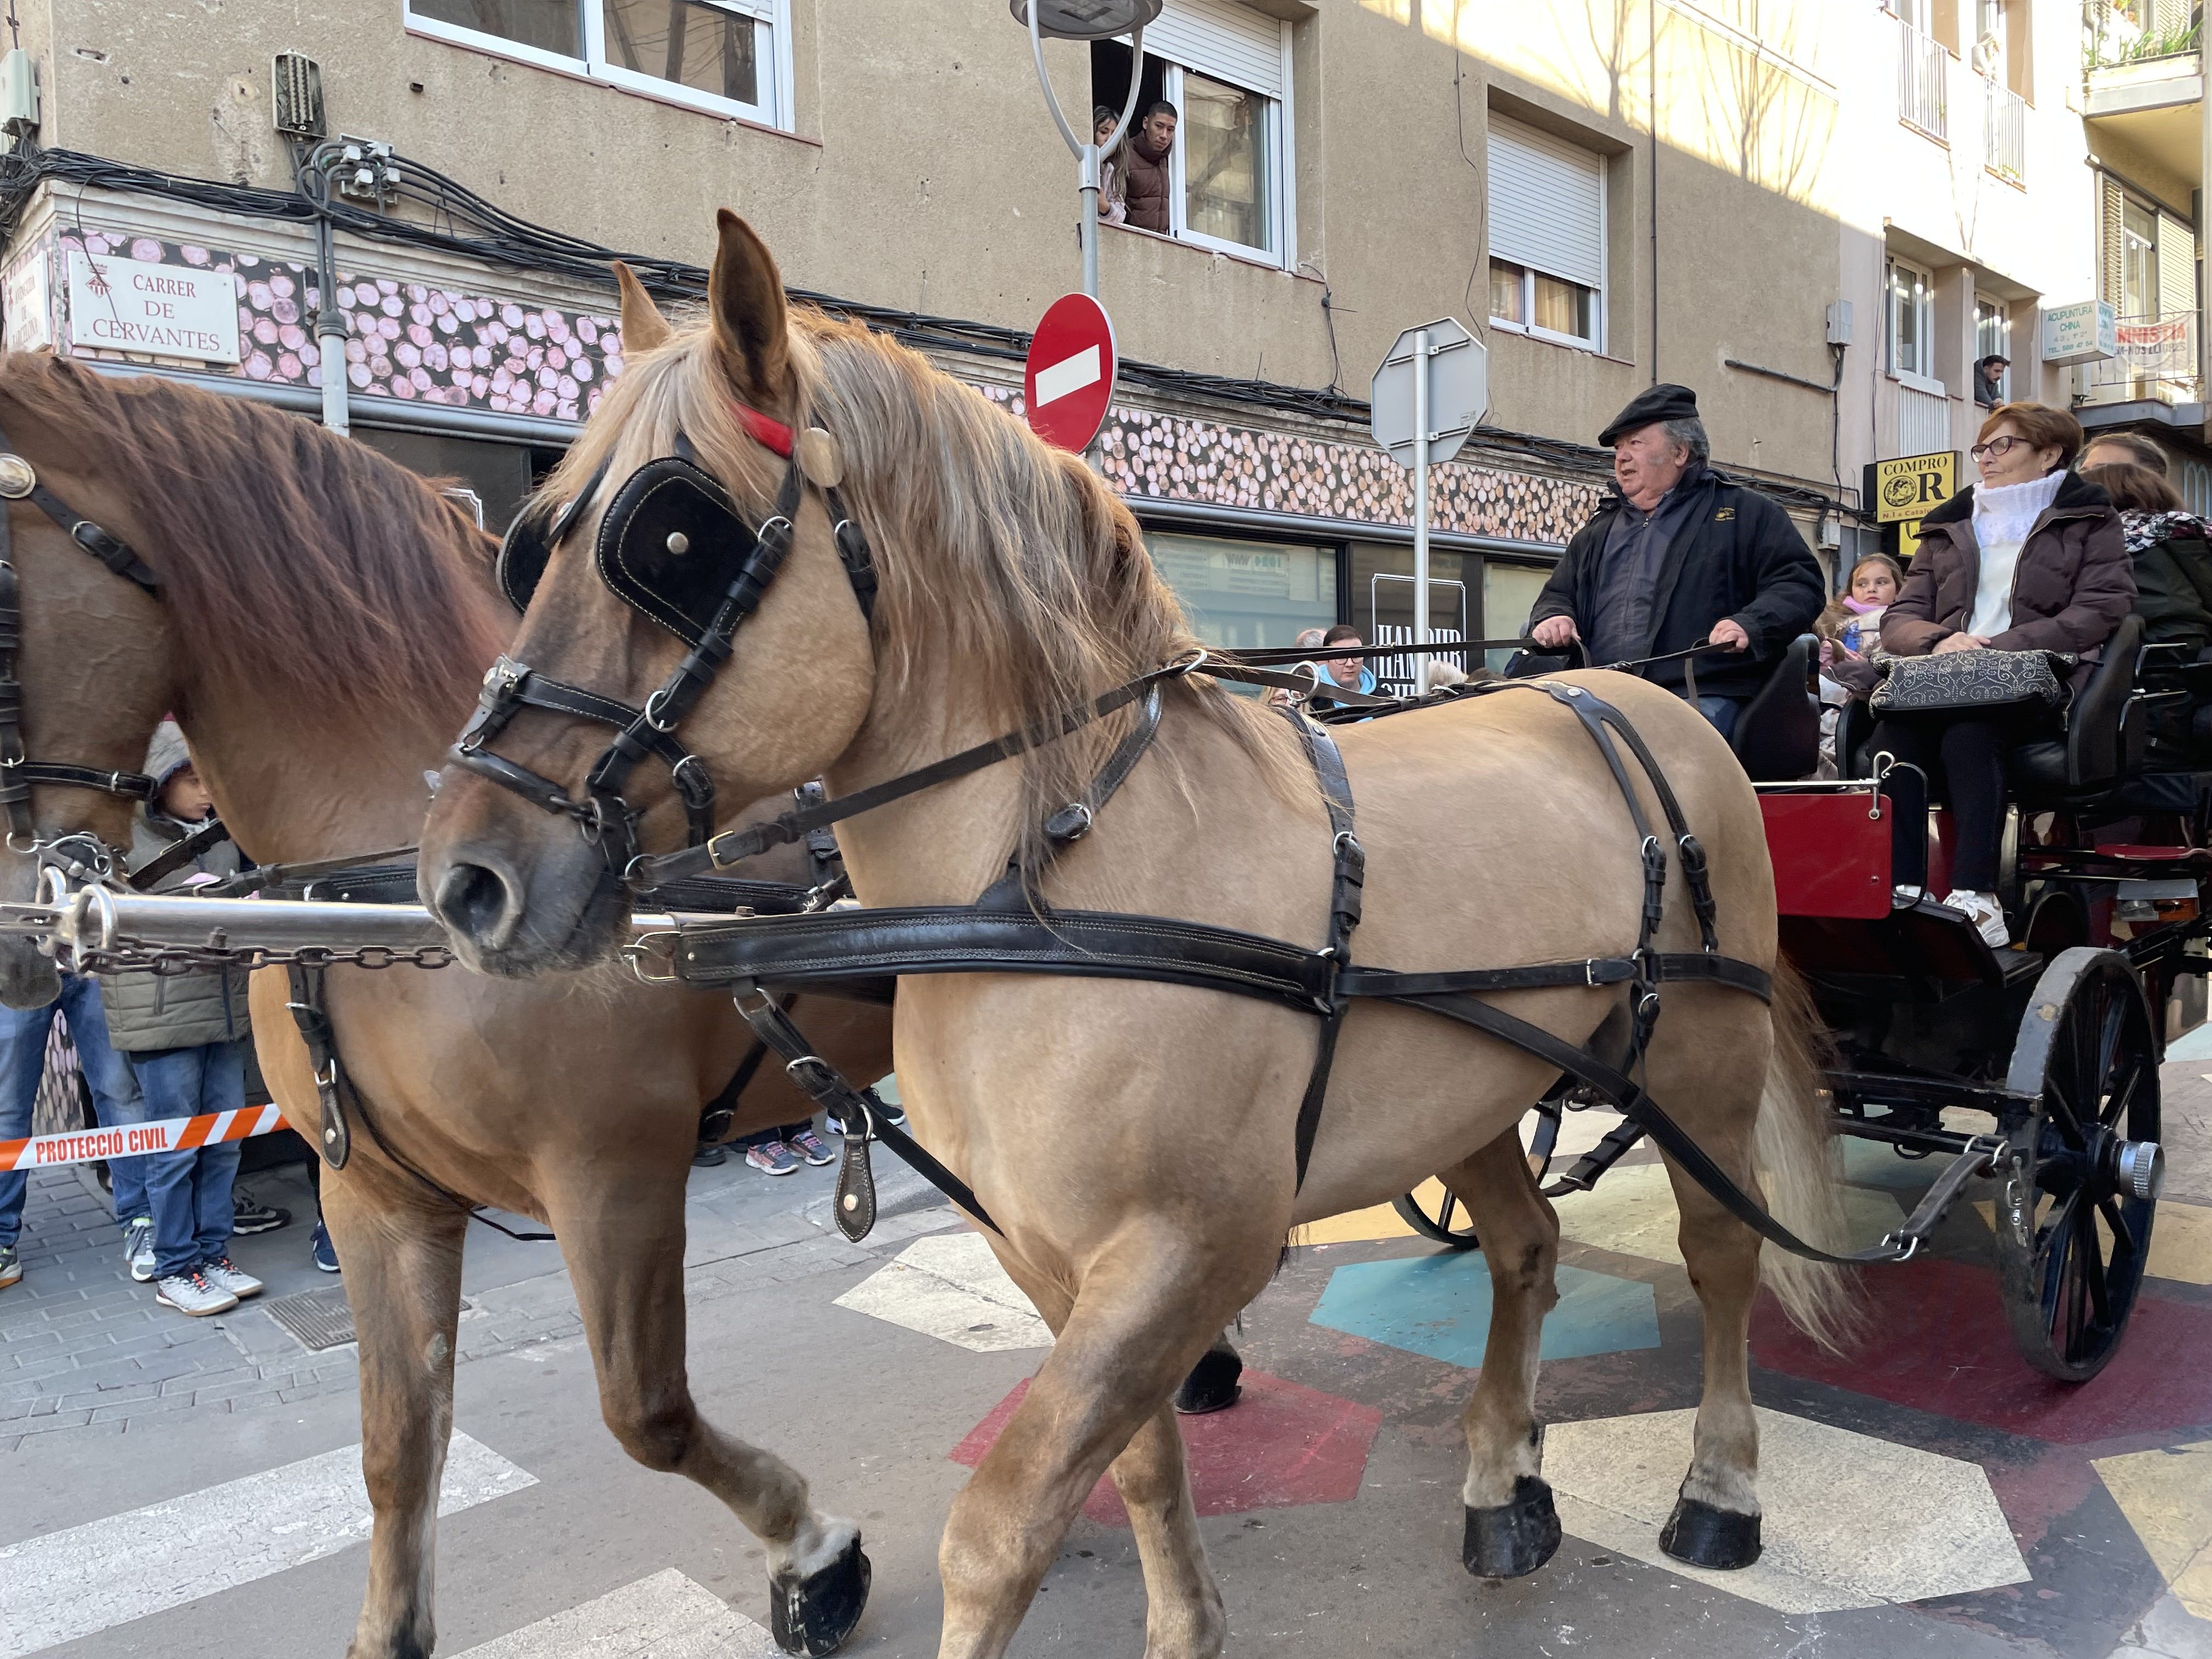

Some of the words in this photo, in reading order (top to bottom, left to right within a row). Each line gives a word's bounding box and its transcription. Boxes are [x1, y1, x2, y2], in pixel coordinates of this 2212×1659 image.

[133, 274, 196, 298] CARRER
[144, 300, 175, 319] DE
[2047, 305, 2093, 322] ACUPUNTURA
[93, 319, 220, 351] CERVANTES
[2059, 320, 2080, 332] CHINA
[2115, 322, 2186, 343] MNISTIA
[1884, 456, 1947, 476] COMPRO
[35, 1128, 123, 1164] PROTECCIÓ
[128, 1127, 168, 1152] CIVIL
